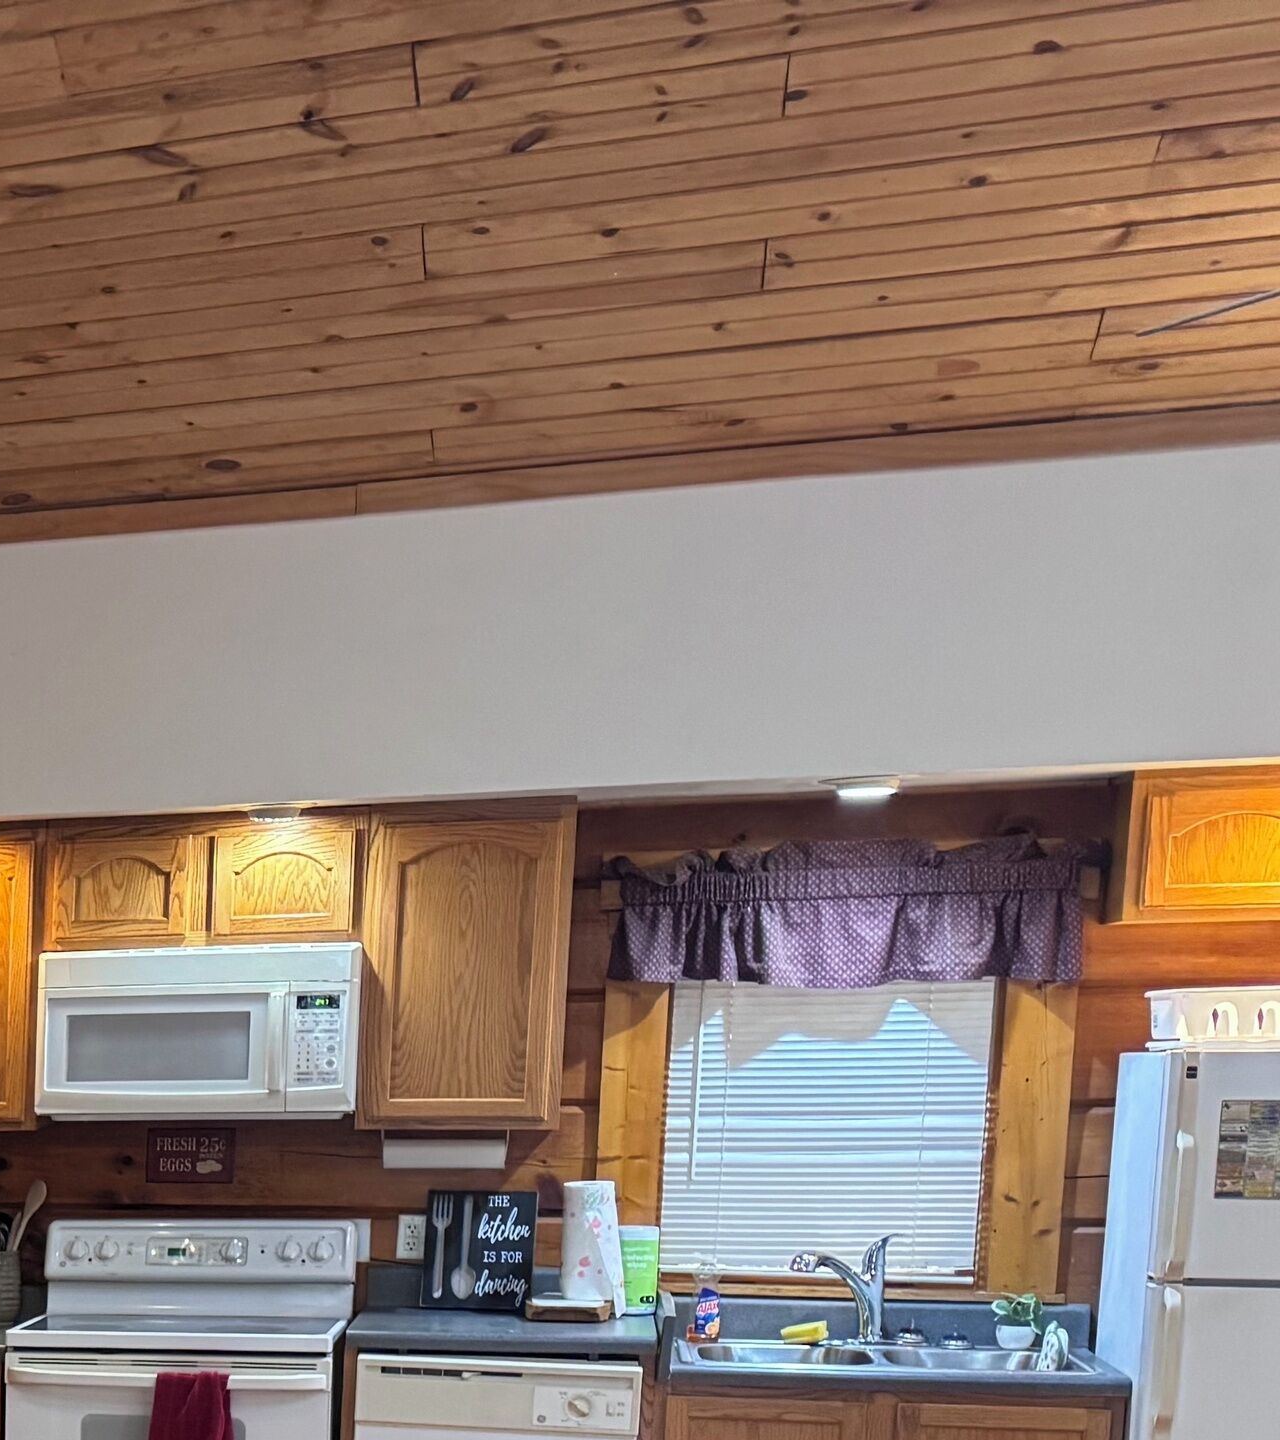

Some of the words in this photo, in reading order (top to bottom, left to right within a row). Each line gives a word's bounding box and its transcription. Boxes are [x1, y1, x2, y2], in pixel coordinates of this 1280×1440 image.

[156, 1137, 197, 1151] FRESH
[159, 1157, 192, 1172] EGGS
[488, 1195, 510, 1207] THE
[477, 1207, 531, 1244] kitchen
[483, 1251, 496, 1263] IS
[501, 1251, 523, 1263] FOR
[474, 1269, 529, 1308] dancing
[697, 1299, 720, 1315] AJAX
